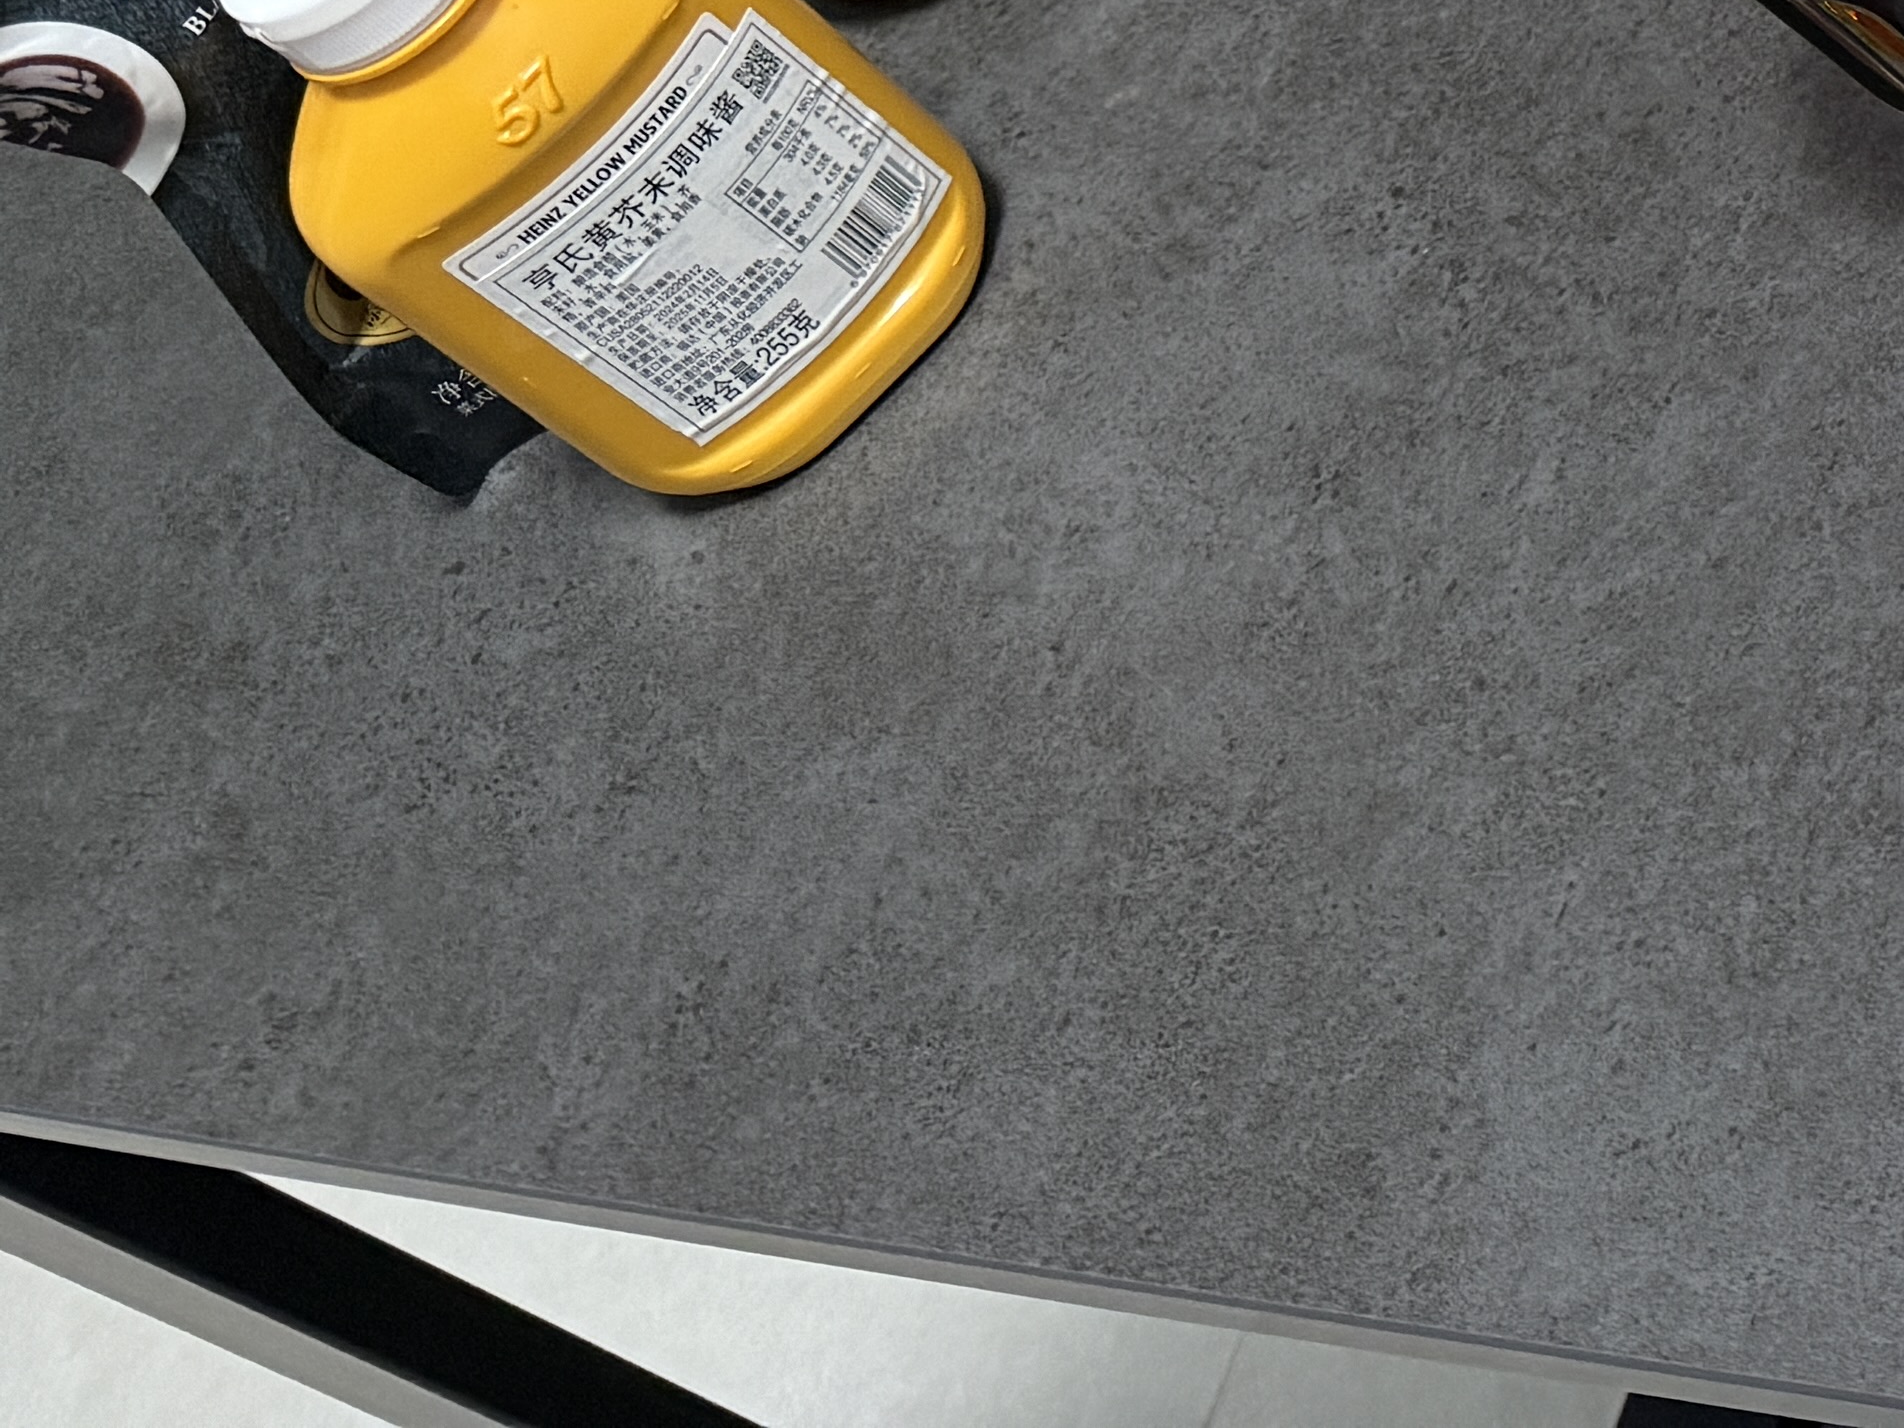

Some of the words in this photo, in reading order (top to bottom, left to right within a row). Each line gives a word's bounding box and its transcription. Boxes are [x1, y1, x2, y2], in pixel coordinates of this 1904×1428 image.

[491, 53, 565, 147] 57
[517, 203, 566, 246] HEINZ
[561, 151, 626, 209] YELLOW
[622, 84, 689, 154] MUSTARD
[522, 87, 745, 296] 亨氏黄芥末调味酱
